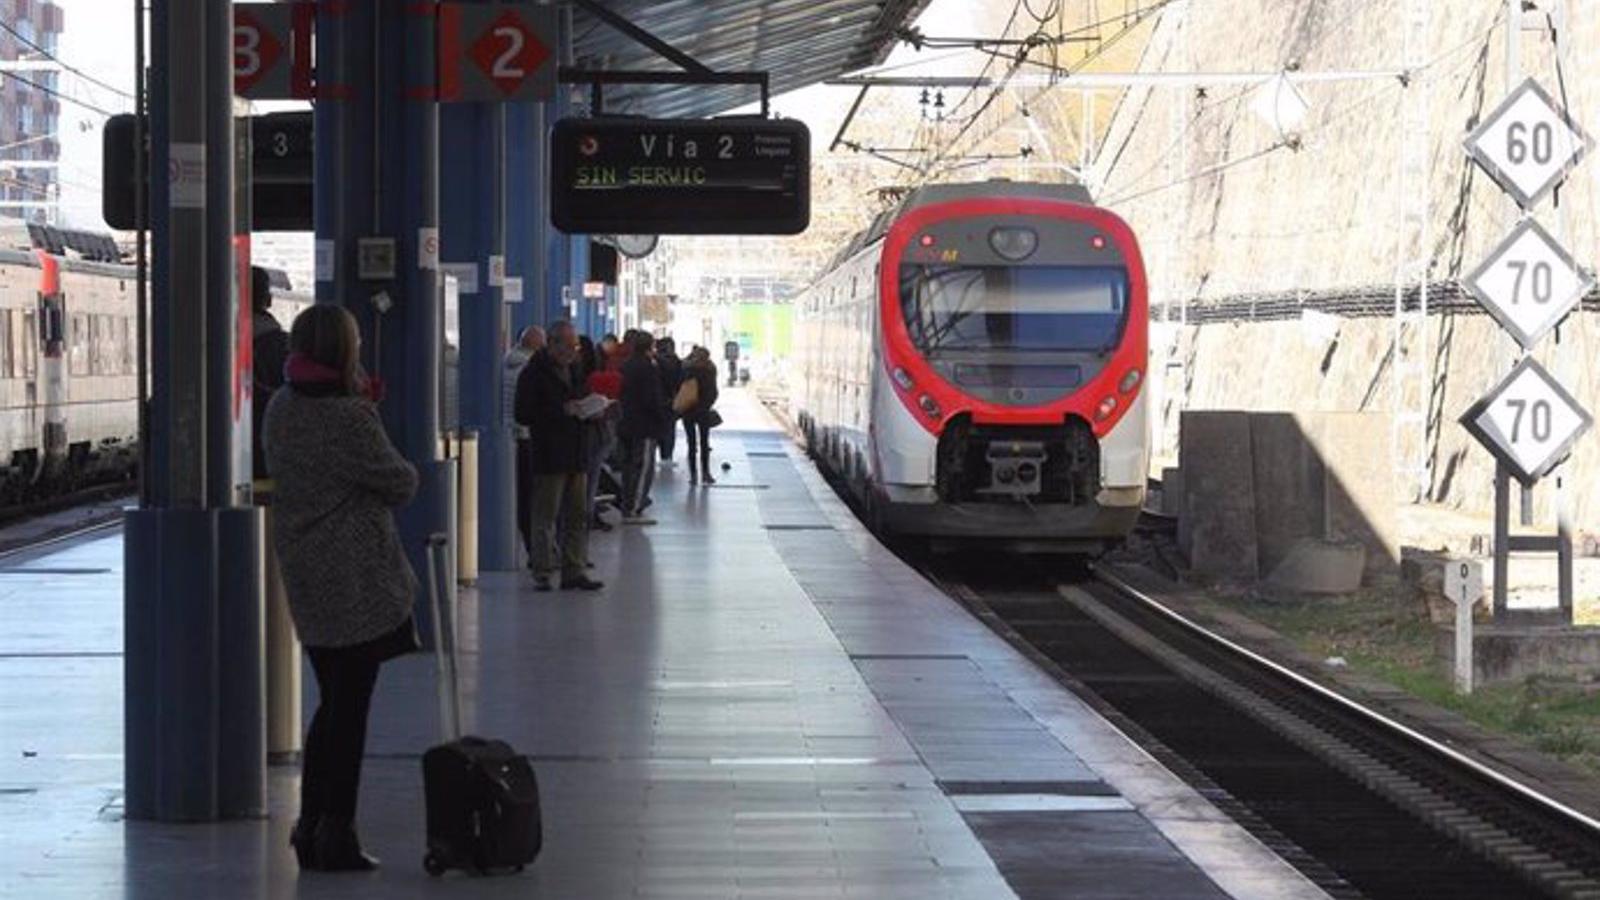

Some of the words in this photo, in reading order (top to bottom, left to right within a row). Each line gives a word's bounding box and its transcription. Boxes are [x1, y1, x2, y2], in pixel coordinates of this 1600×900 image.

[234, 26, 261, 76] 3
[492, 27, 525, 78] 2
[273, 131, 289, 157] 3
[717, 134, 734, 159] 2
[1505, 121, 1553, 165] 60
[576, 166, 616, 185] SIN
[1505, 260, 1552, 305] 70
[1505, 398, 1552, 443] 70
[1460, 563, 1468, 578] 0
